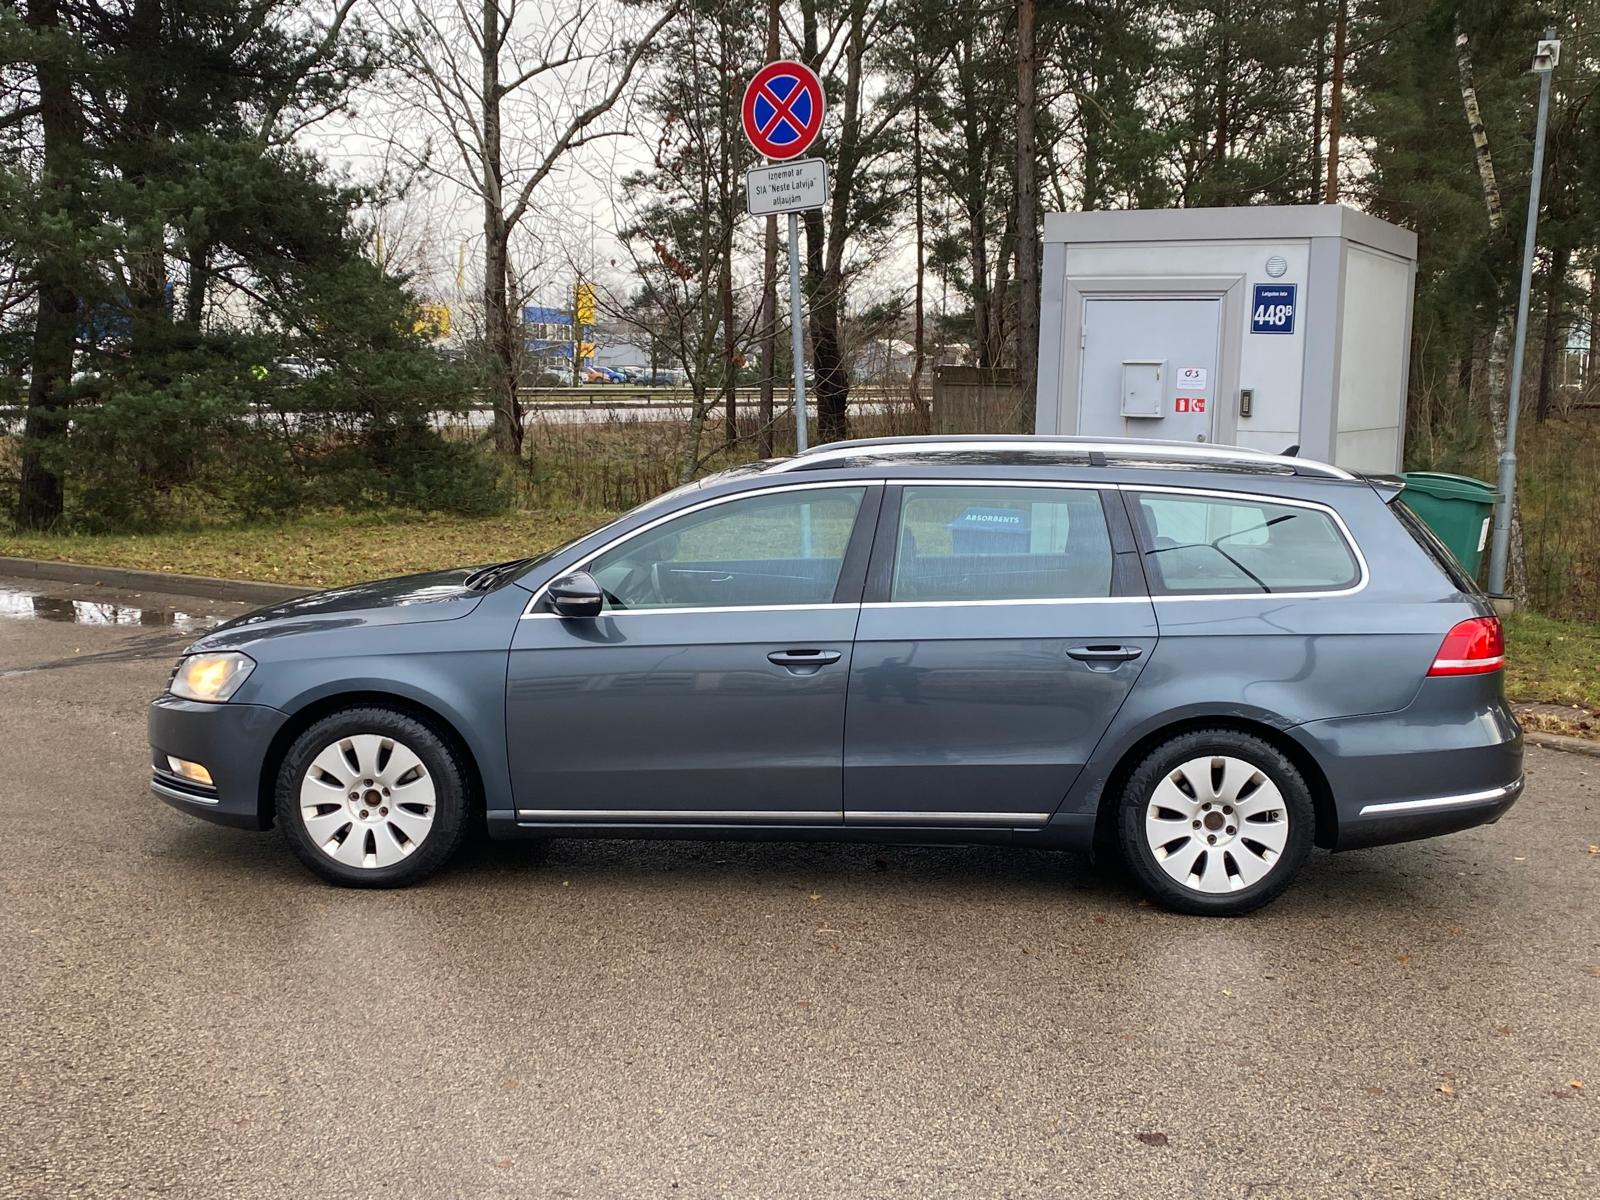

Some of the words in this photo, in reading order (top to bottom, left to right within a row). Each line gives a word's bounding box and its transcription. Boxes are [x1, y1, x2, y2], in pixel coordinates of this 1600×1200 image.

[768, 169, 794, 181] Izņemot
[756, 185, 767, 195] SIA
[768, 183, 790, 193] "Neste
[792, 177, 816, 190] Latvija"
[965, 514, 1020, 524] ABSORBENTS
